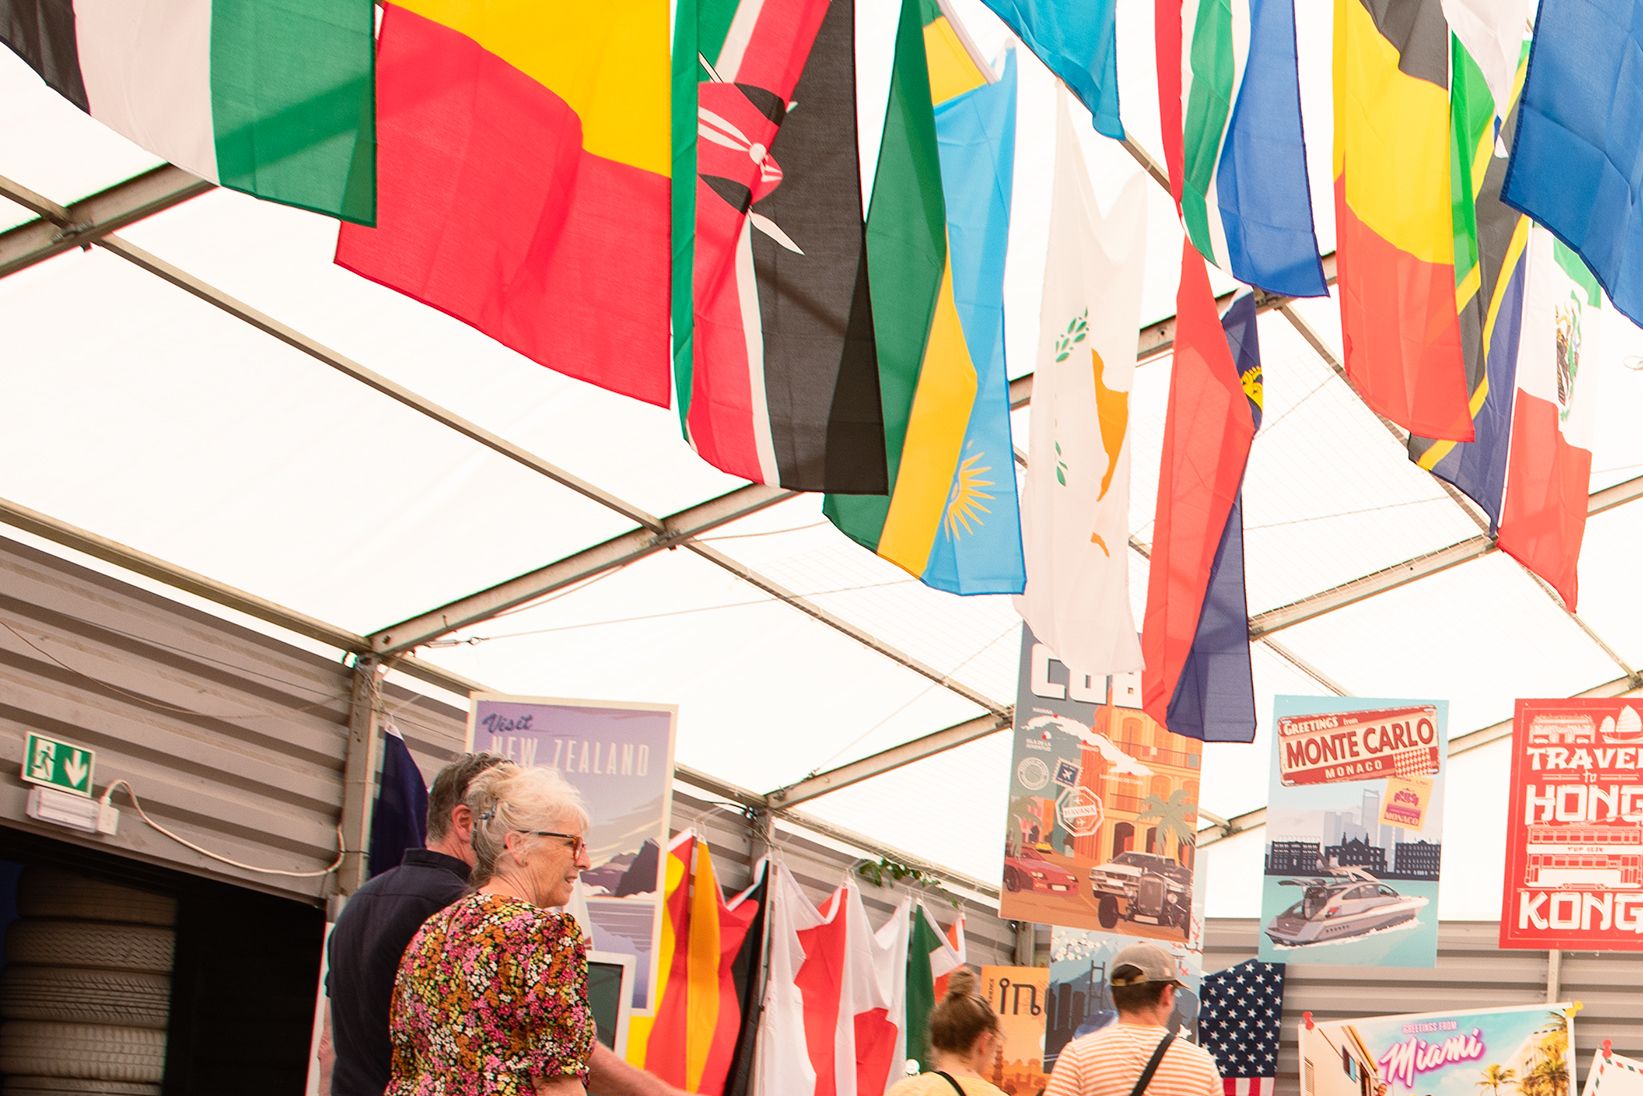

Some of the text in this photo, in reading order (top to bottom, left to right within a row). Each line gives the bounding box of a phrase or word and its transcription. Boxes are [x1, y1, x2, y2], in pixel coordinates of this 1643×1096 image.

[1031, 643, 1143, 710] CUB
[482, 713, 534, 734] Visit
[1283, 716, 1339, 736] GREETINGS
[1285, 718, 1434, 769] MONTE CARLO
[490, 735, 650, 777] NEW ZEALAND
[1325, 760, 1383, 779] MONACO
[1583, 769, 1597, 783] to
[1385, 811, 1419, 826] MONACO
[1402, 1020, 1457, 1034] GREETINGS FROM
[1380, 1027, 1483, 1088] Miami
